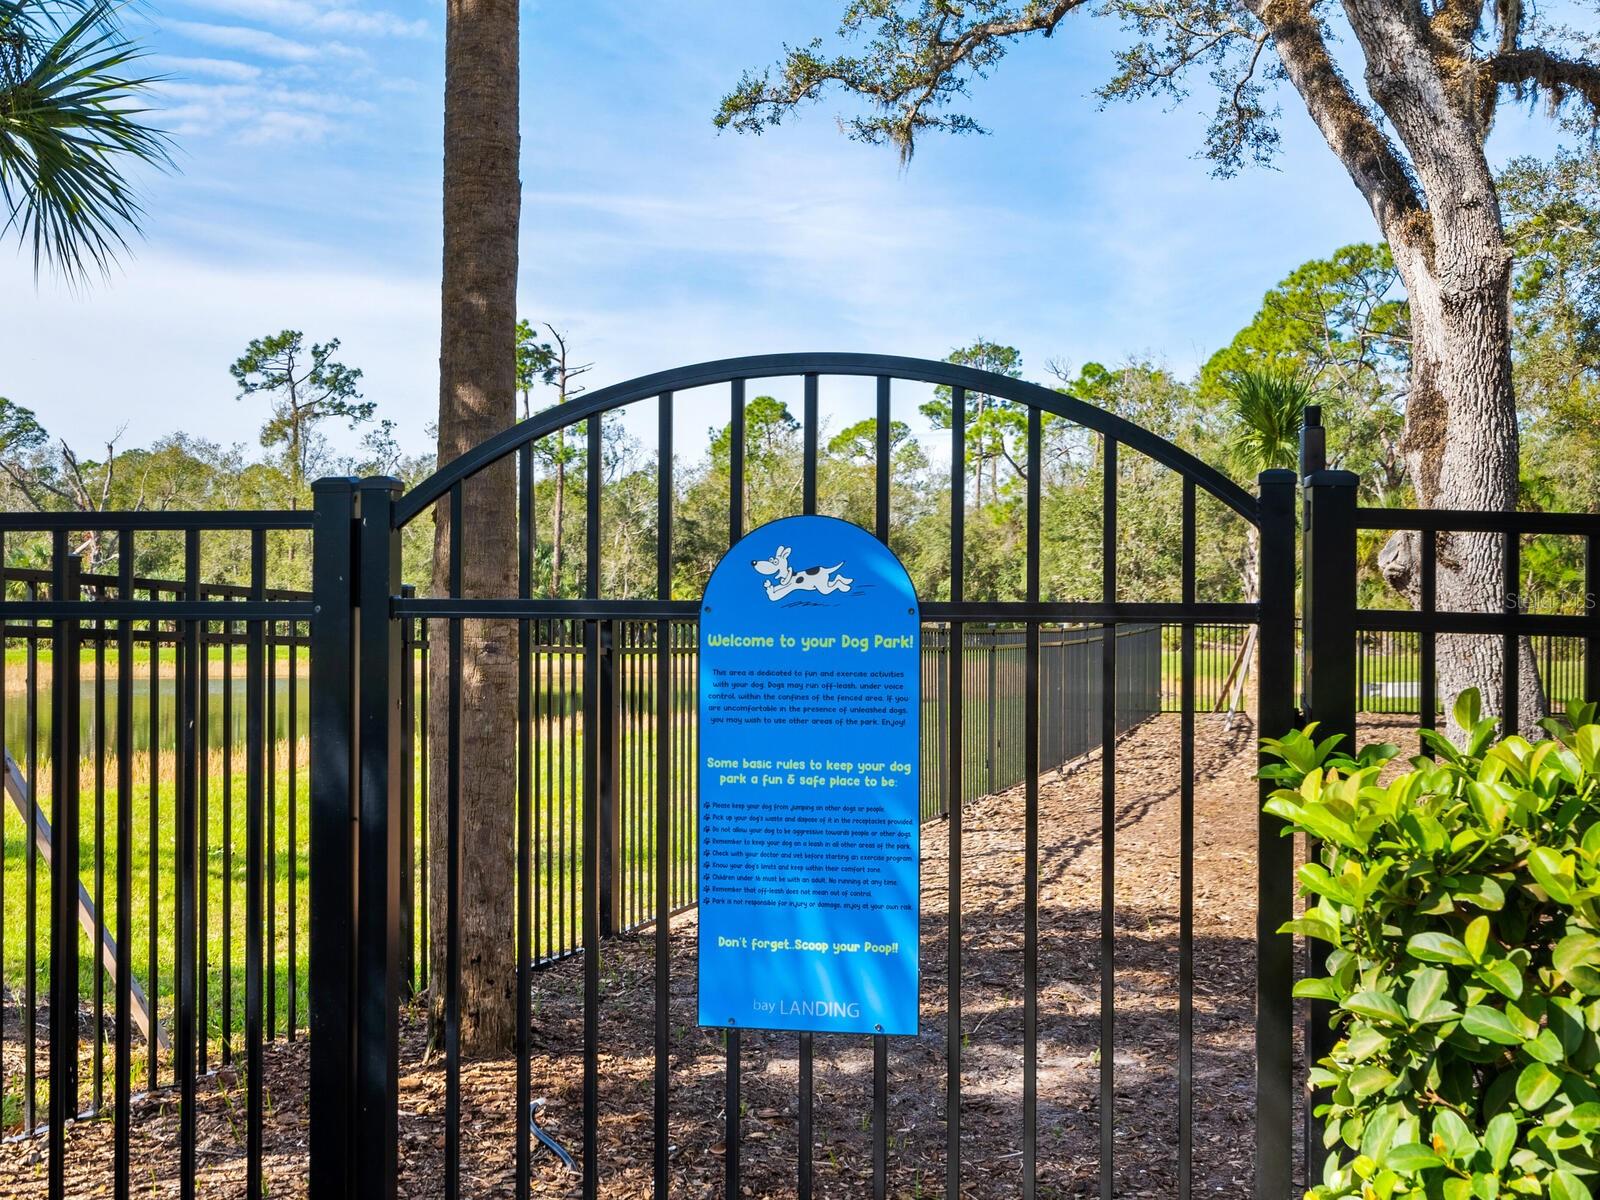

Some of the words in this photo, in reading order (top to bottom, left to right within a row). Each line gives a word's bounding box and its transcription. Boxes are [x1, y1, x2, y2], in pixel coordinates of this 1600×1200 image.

[708, 634, 774, 647] Welcome
[779, 635, 795, 647] to
[801, 637, 836, 651] your
[841, 635, 868, 652] Dog
[874, 635, 913, 648] Park!
[804, 670, 817, 679] fun
[767, 682, 784, 690] Dogs
[777, 693, 809, 702] confines
[837, 694, 862, 703] fenced
[723, 705, 777, 714] uncomfortable
[802, 707, 836, 715] presence
[725, 718, 742, 726] may
[707, 757, 738, 769] Some
[742, 758, 771, 769] basic
[776, 758, 805, 770] rules
[809, 759, 822, 770] to
[826, 759, 853, 773] keep
[857, 762, 885, 773] your
[889, 760, 911, 774] dog
[719, 773, 746, 787] park
[750, 776, 758, 785] a
[762, 774, 782, 786] fun
[786, 774, 795, 786] &
[799, 774, 825, 786] safe
[829, 775, 860, 789] place
[864, 776, 877, 787] to
[881, 776, 897, 787] be:
[718, 936, 747, 948] Don't
[832, 943, 860, 954] your
[863, 941, 898, 955] Poop!!
[753, 1000, 775, 1014] bay
[780, 1001, 860, 1018] LANDING
